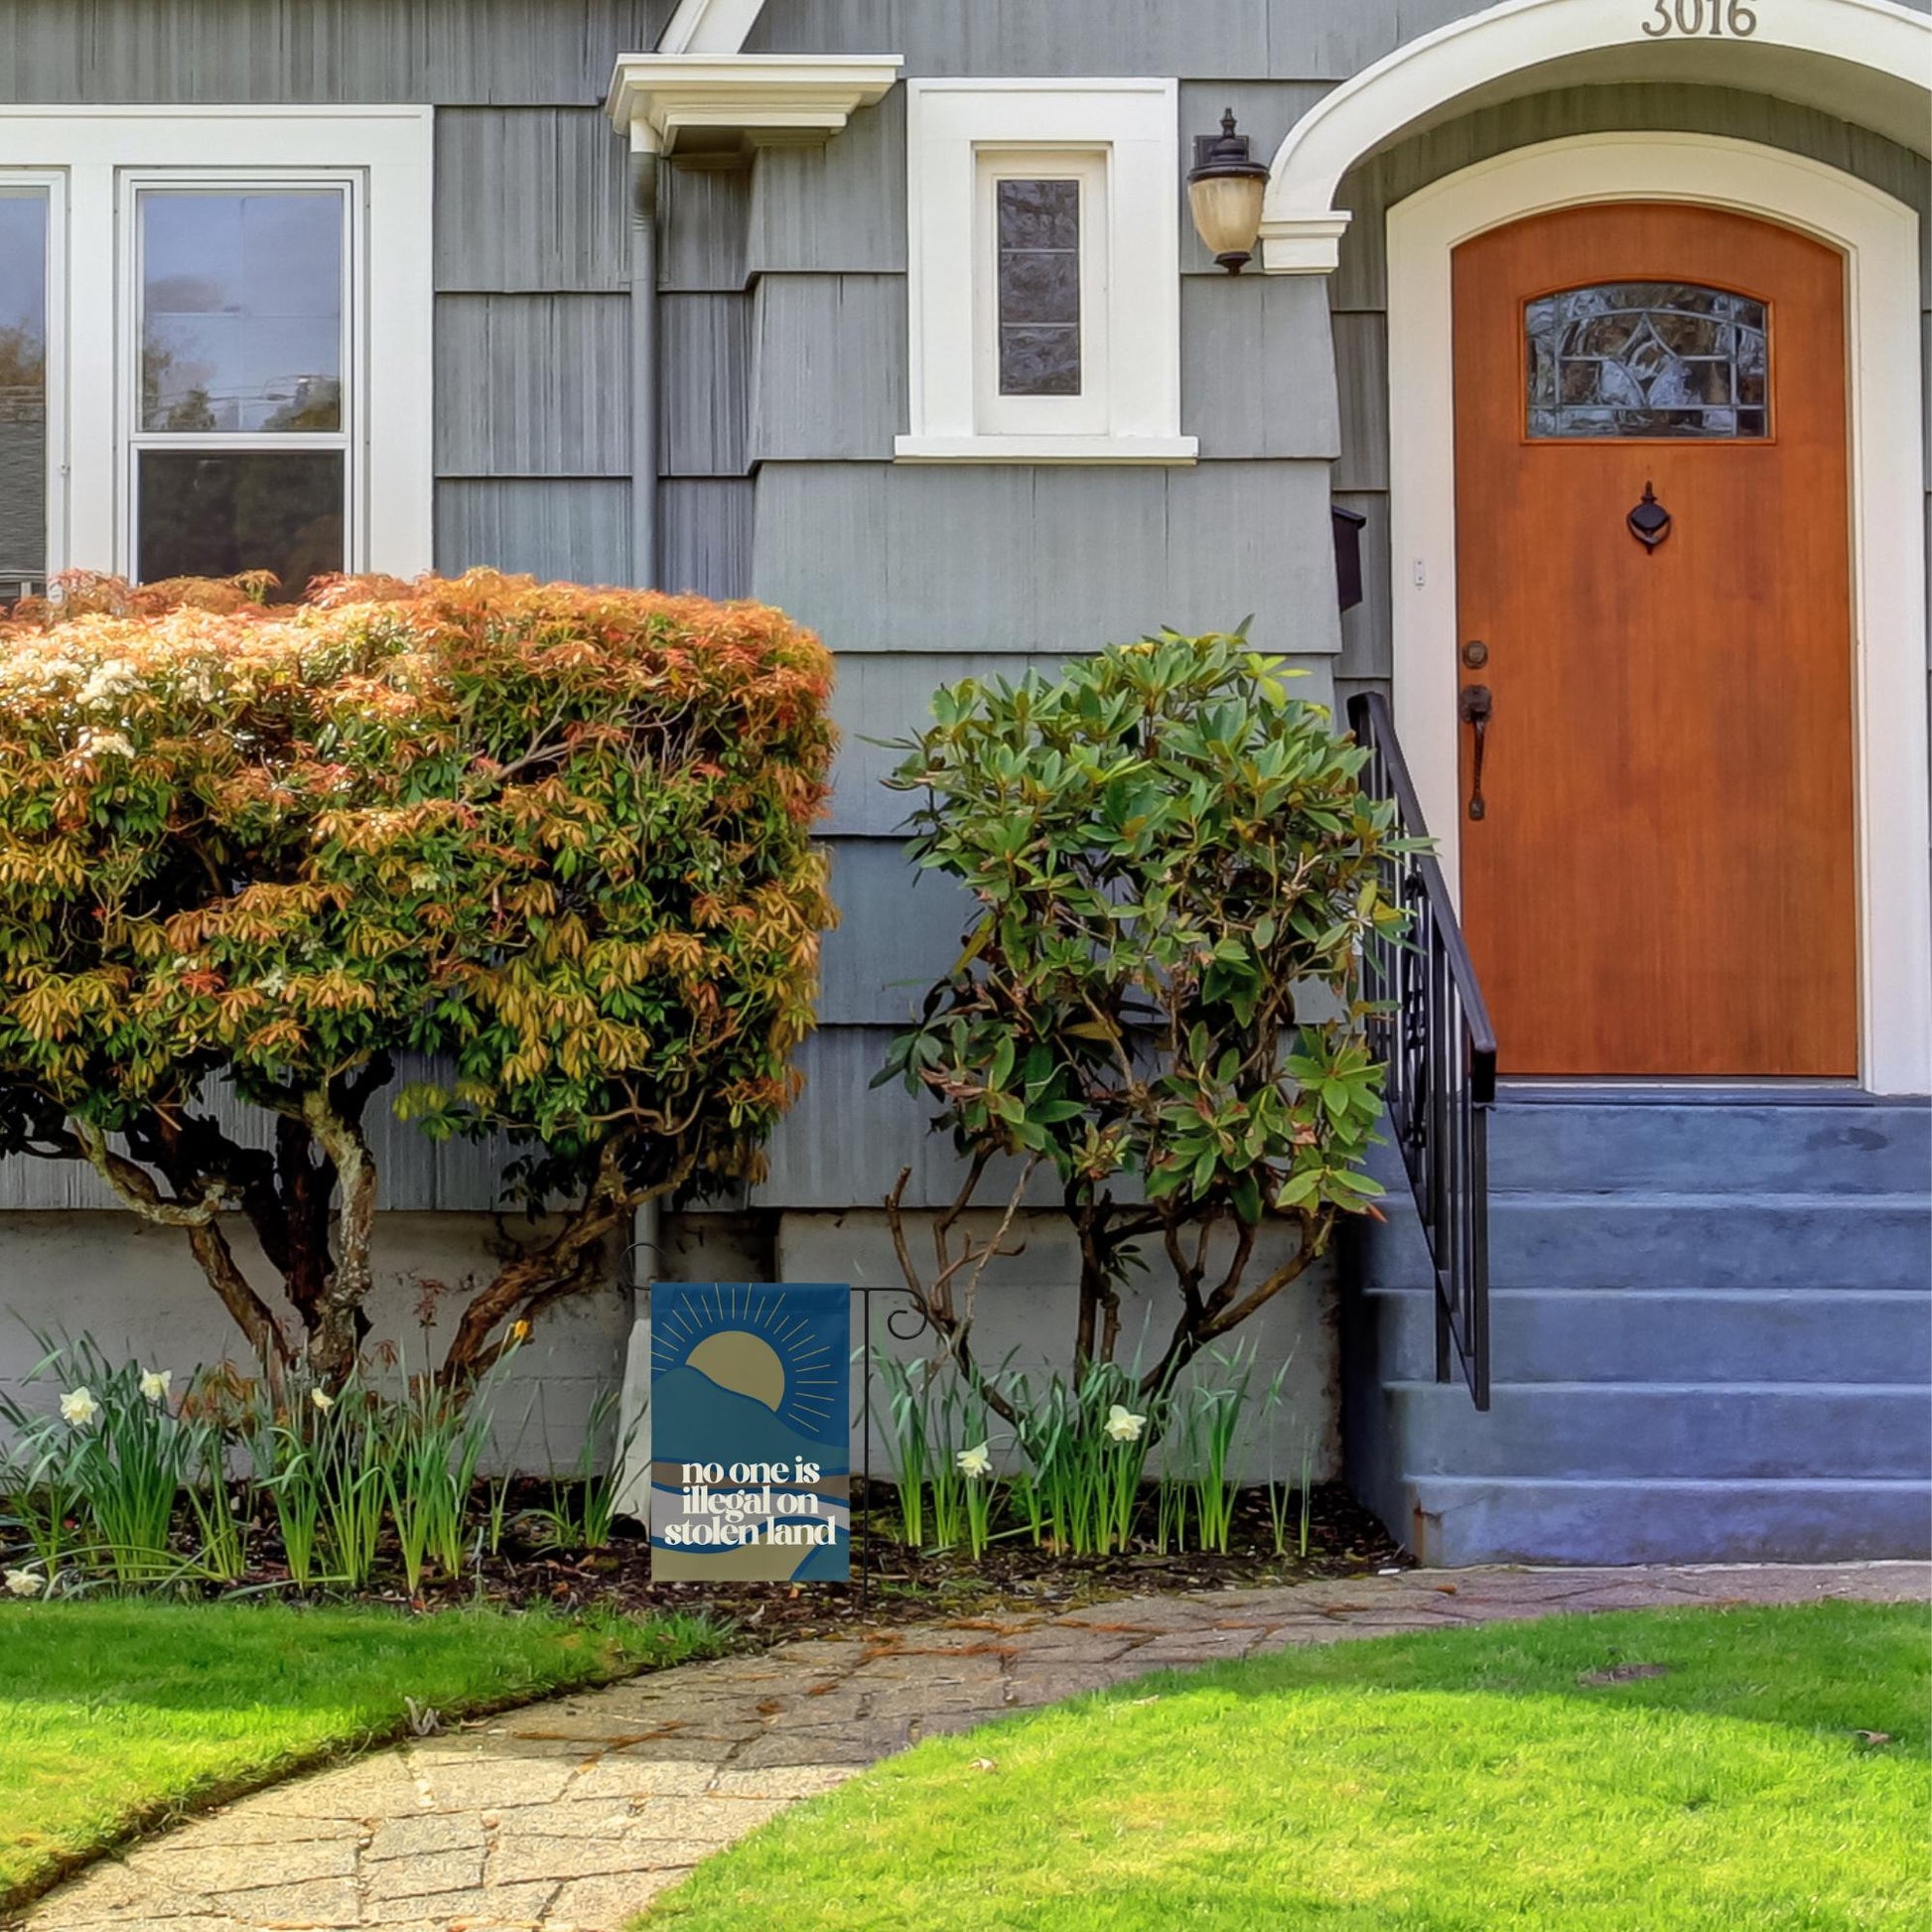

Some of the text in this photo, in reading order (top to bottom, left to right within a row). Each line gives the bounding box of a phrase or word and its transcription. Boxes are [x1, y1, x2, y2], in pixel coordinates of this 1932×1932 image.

[1641, 0, 1756, 37] 3016
[682, 1454, 821, 1484] no one is
[682, 1484, 819, 1523] illegal on
[664, 1515, 837, 1546] stolen land
